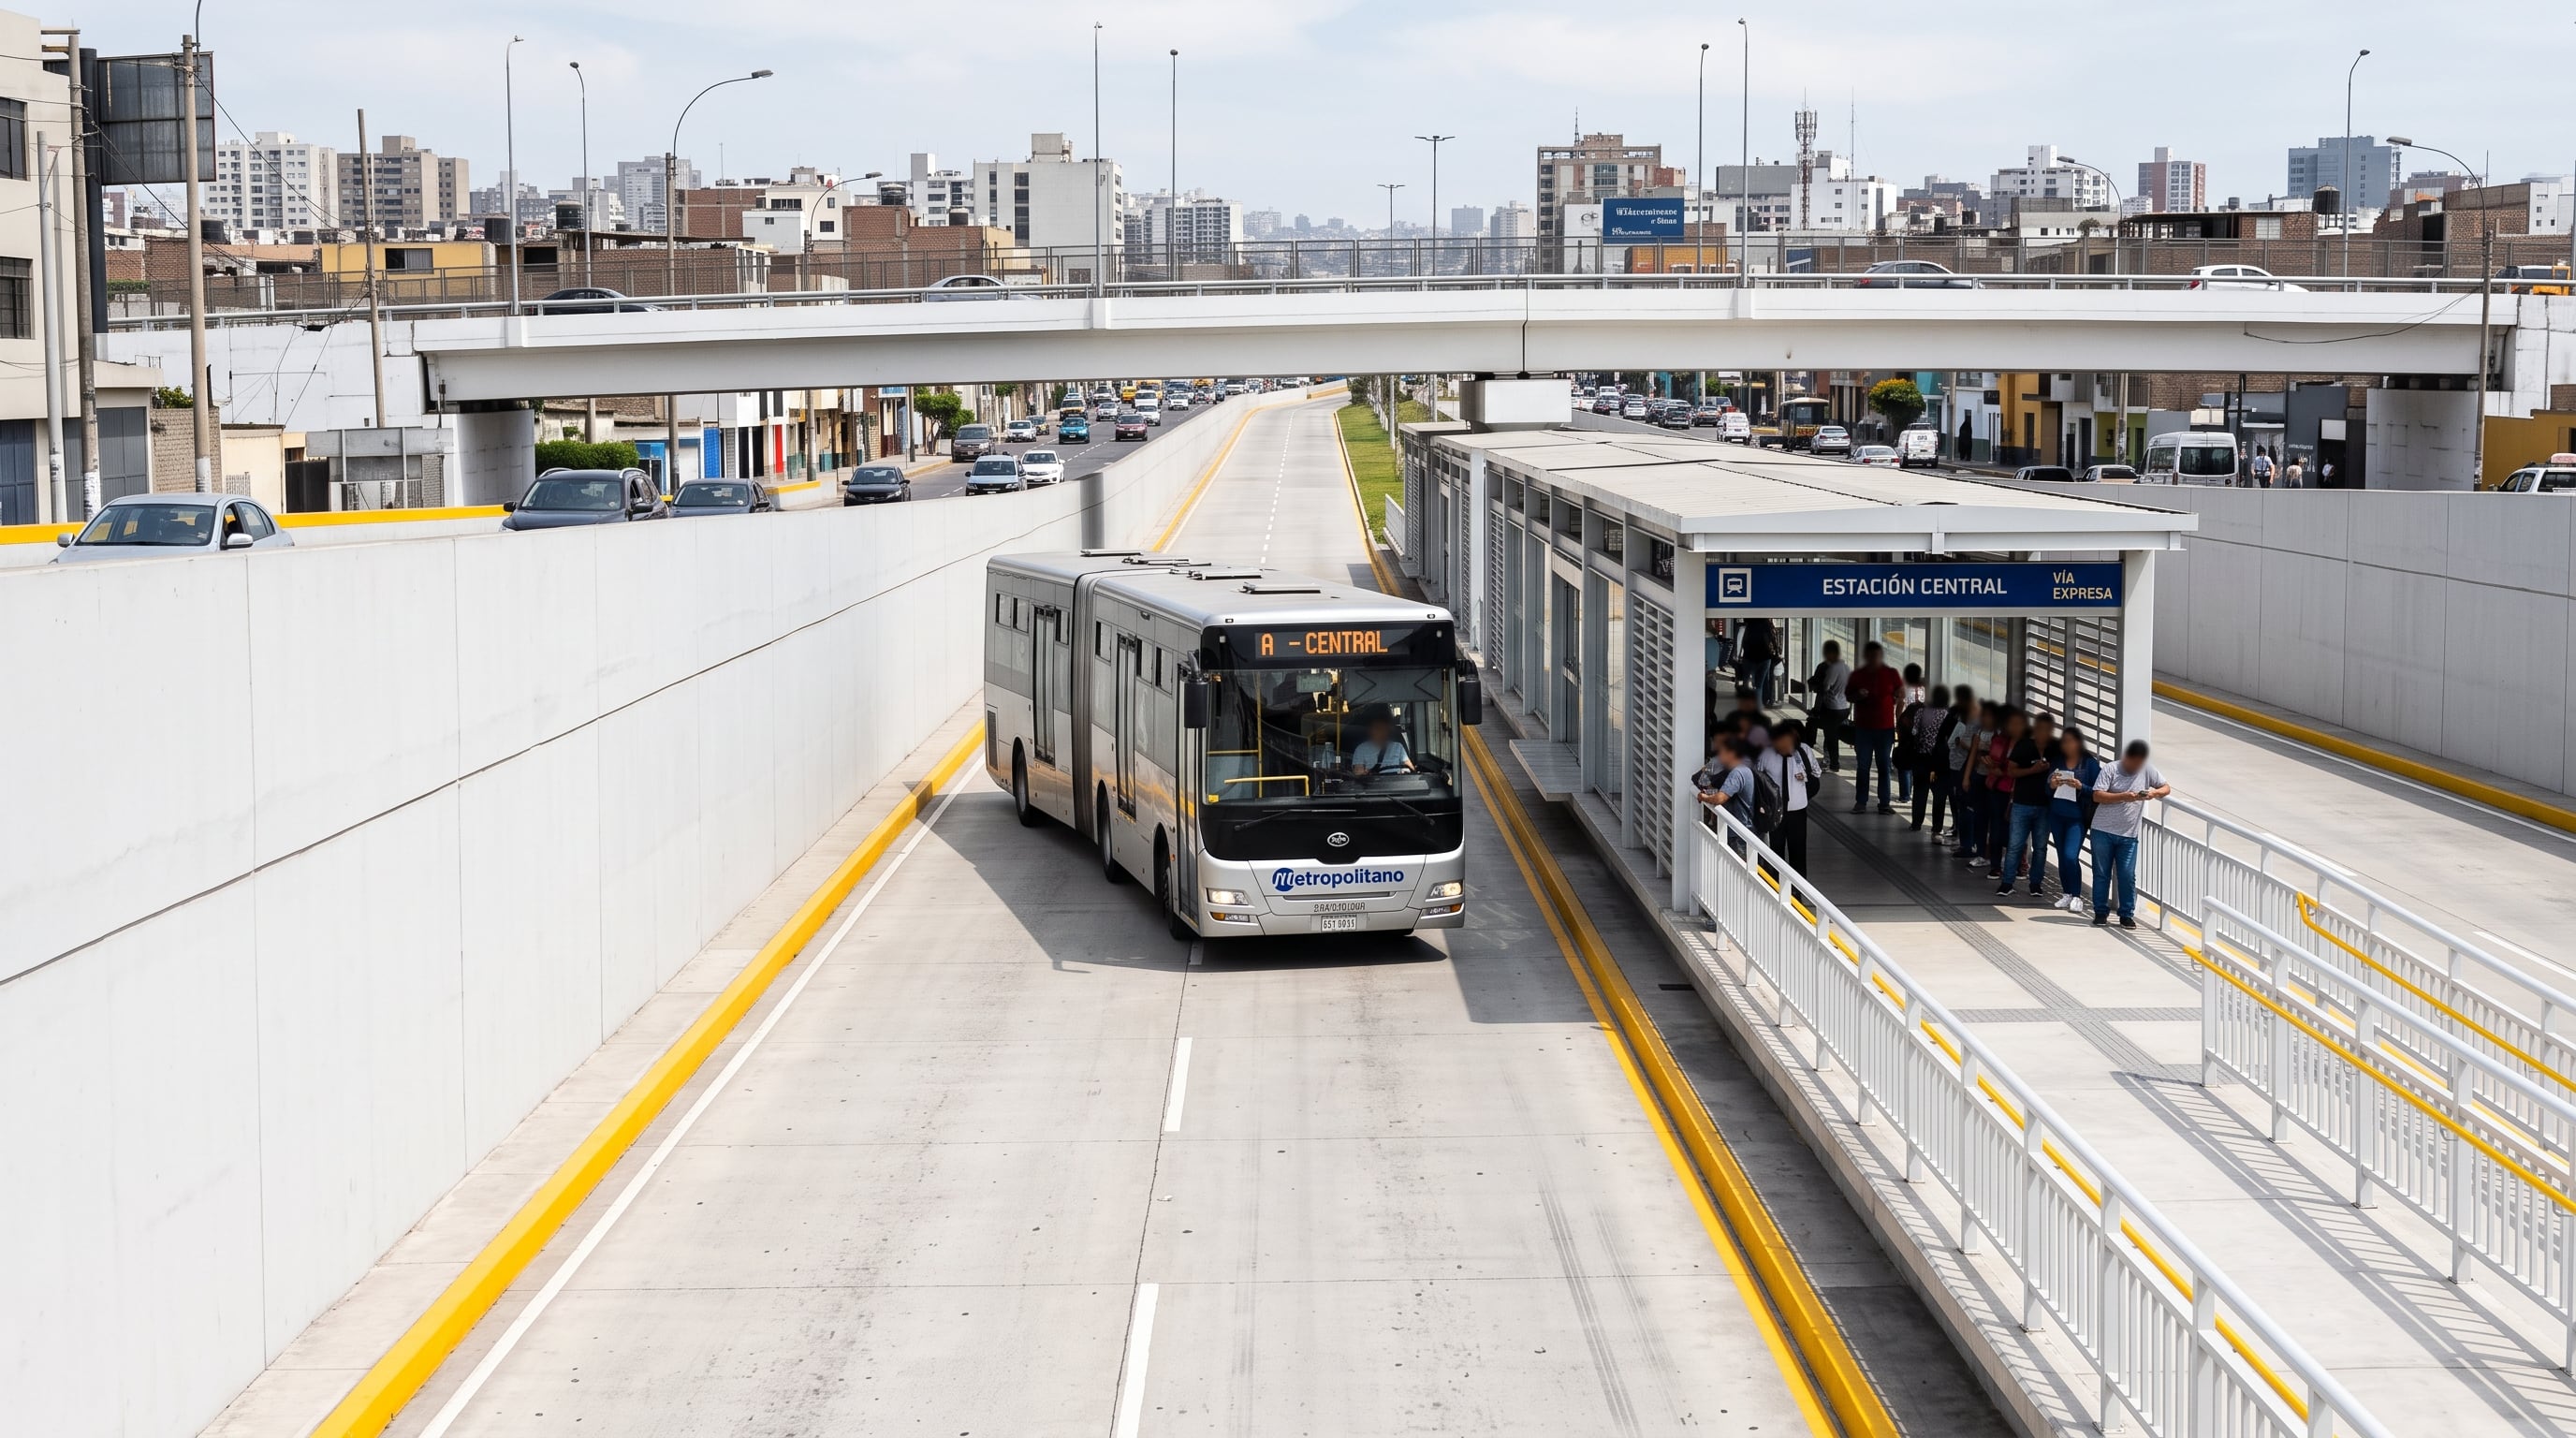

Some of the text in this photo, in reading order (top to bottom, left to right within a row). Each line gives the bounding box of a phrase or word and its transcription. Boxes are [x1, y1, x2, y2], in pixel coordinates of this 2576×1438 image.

[1822, 573, 2008, 594] ESTACIÓN CENTRAL
[2053, 569, 2075, 584] VÍA
[2053, 587, 2113, 600] EXPRESA
[1261, 633, 1274, 655] A
[1305, 630, 1388, 654] CENTRAL
[1272, 867, 1404, 892] Metropolitano
